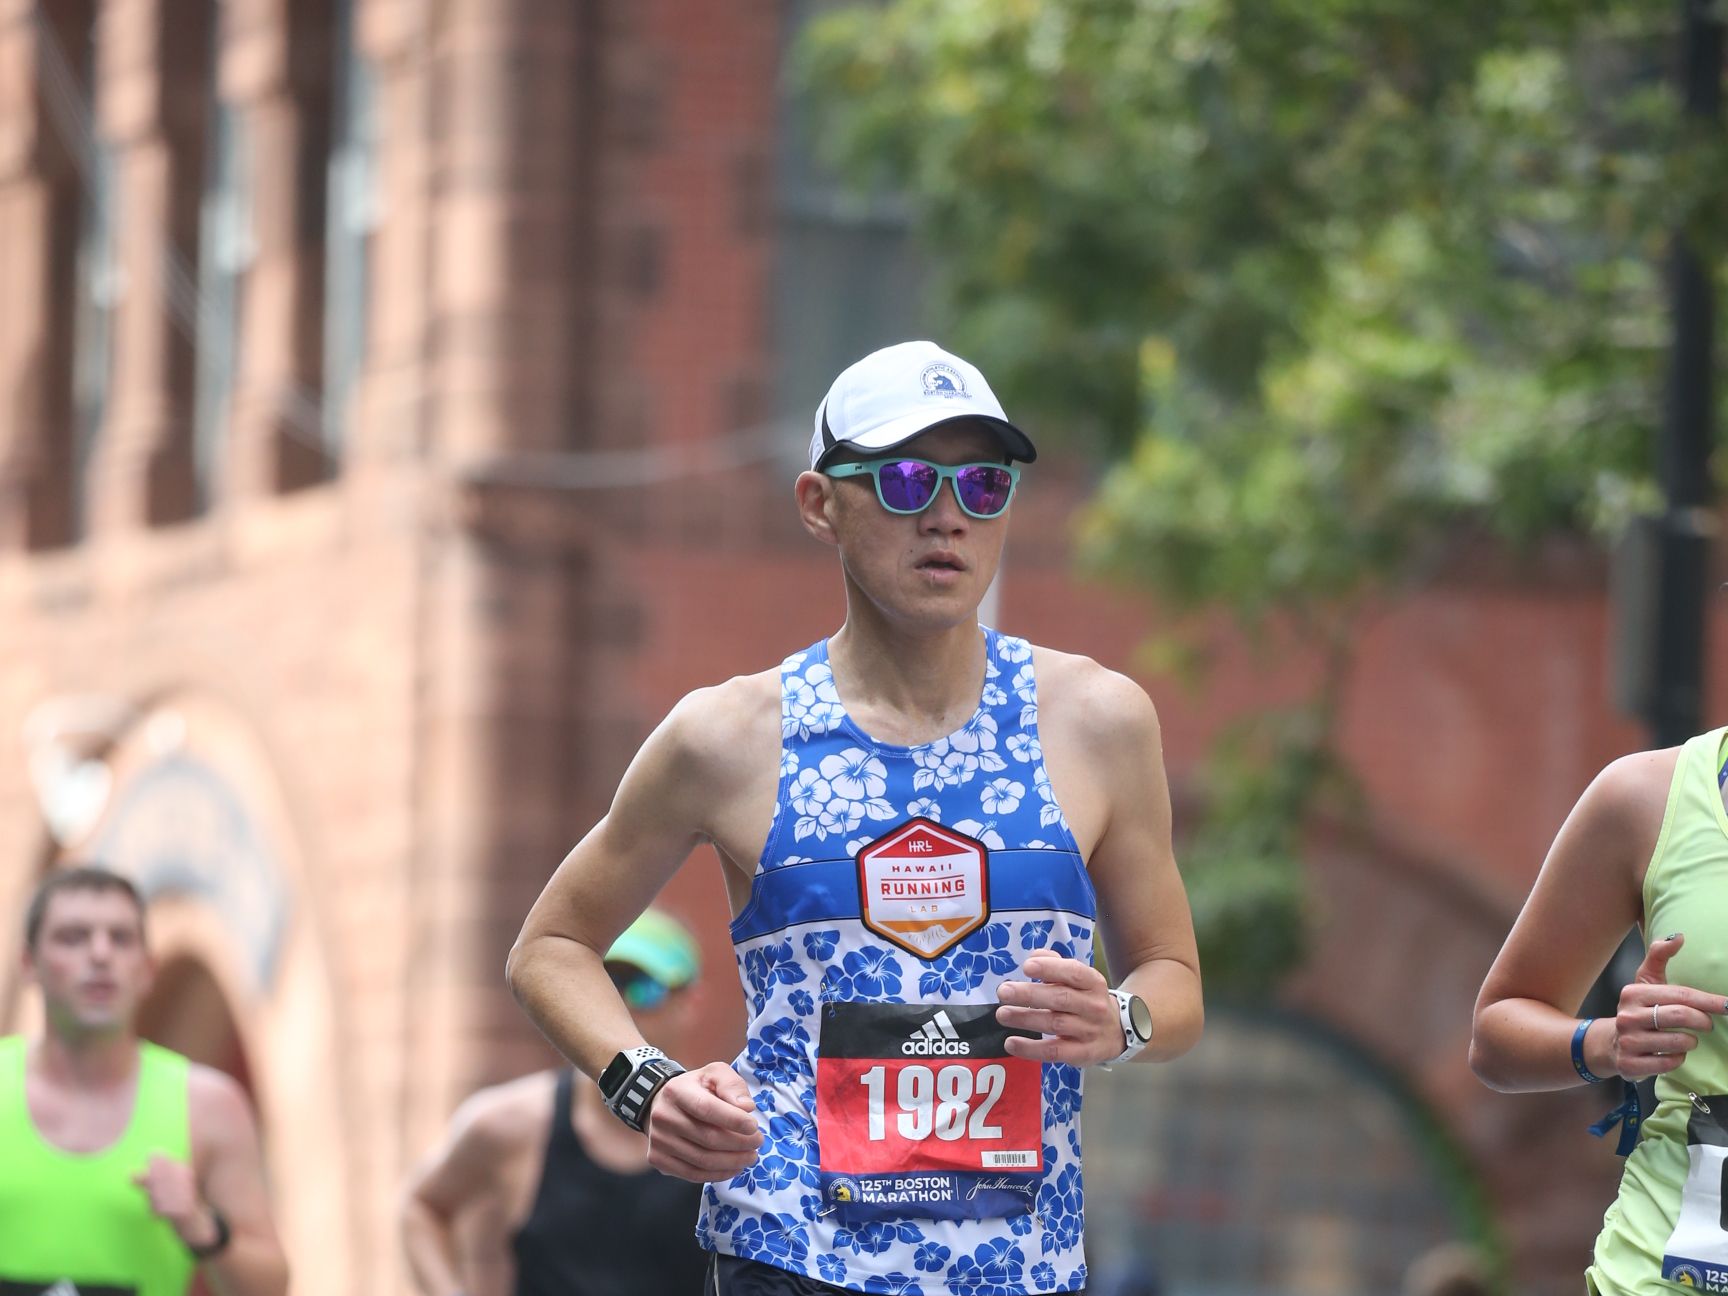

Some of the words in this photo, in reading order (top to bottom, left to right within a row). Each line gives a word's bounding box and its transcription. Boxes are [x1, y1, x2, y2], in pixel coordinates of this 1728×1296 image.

[908, 840, 933, 853] HRL
[892, 863, 952, 873] HAWAII
[881, 878, 966, 895] RUNNING
[909, 905, 939, 913] LAB
[901, 1038, 970, 1055] adidas
[860, 1064, 1006, 1141] 1982
[895, 1177, 950, 1190] BOSTON
[862, 1189, 952, 1203] MARATHON
